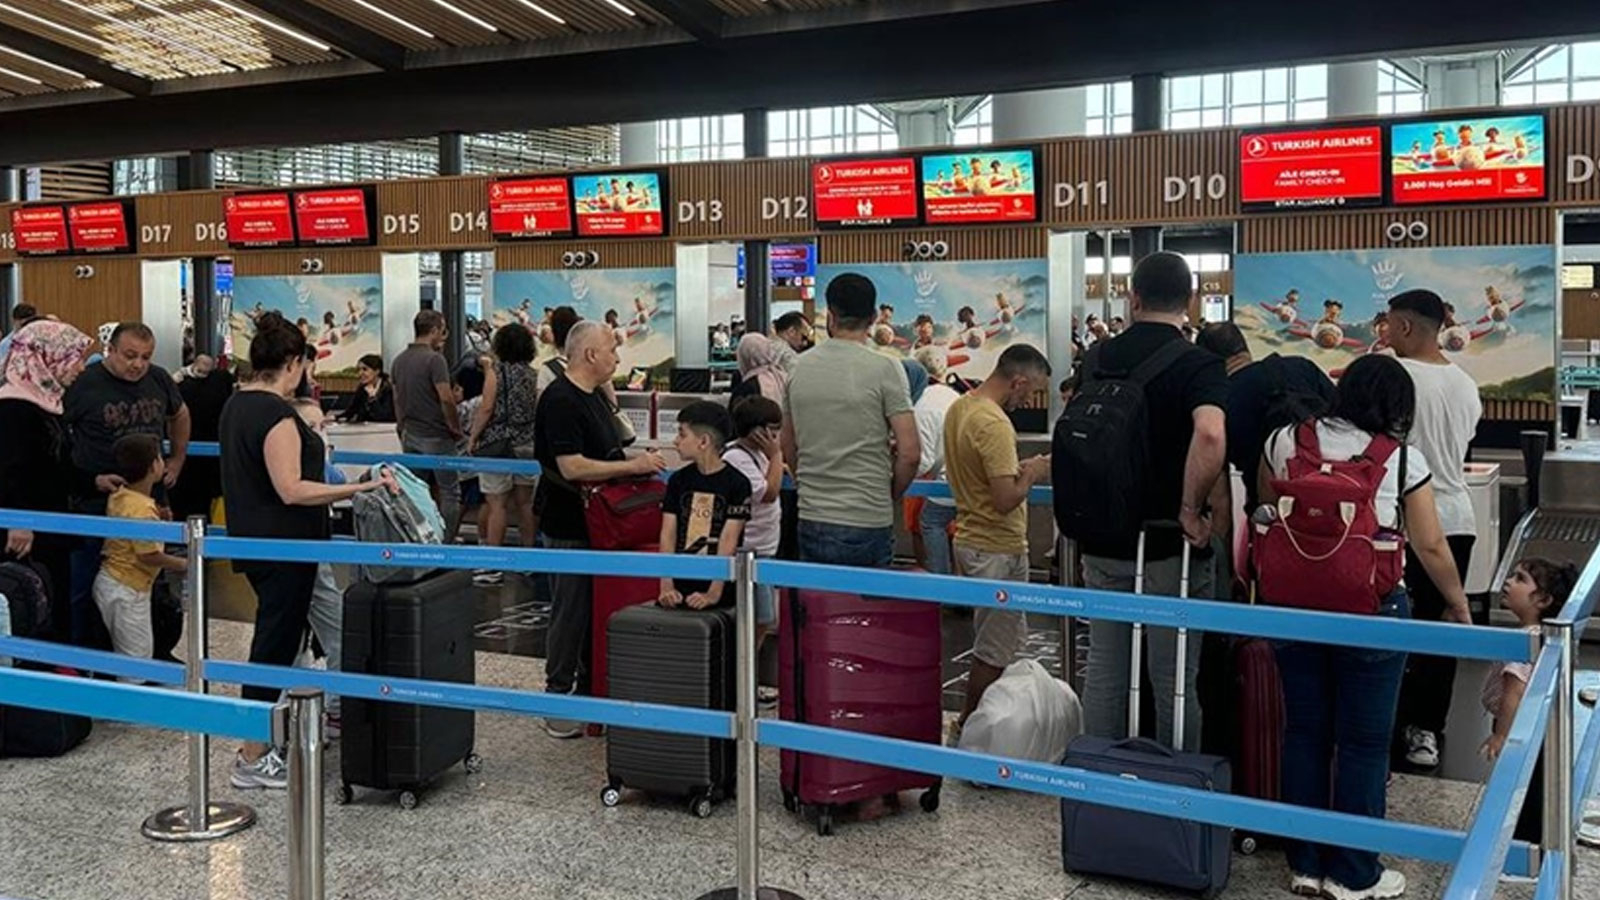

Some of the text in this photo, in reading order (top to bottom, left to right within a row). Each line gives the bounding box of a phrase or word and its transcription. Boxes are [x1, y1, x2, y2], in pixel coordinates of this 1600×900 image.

[1272, 136, 1373, 151] TURKISH AIRLINES
[1566, 154, 1600, 184] D
[1054, 180, 1108, 207] D11
[1164, 173, 1226, 202] D10
[678, 199, 723, 223] D13
[762, 196, 808, 220] D12
[195, 222, 227, 241] D16
[384, 214, 420, 234] D15
[450, 211, 488, 233] D14
[0, 233, 16, 249] 18
[141, 225, 171, 243] D17
[1012, 594, 1083, 609] TURKISH AIRLINES
[1014, 771, 1086, 791] TURKISH AIRLINES
